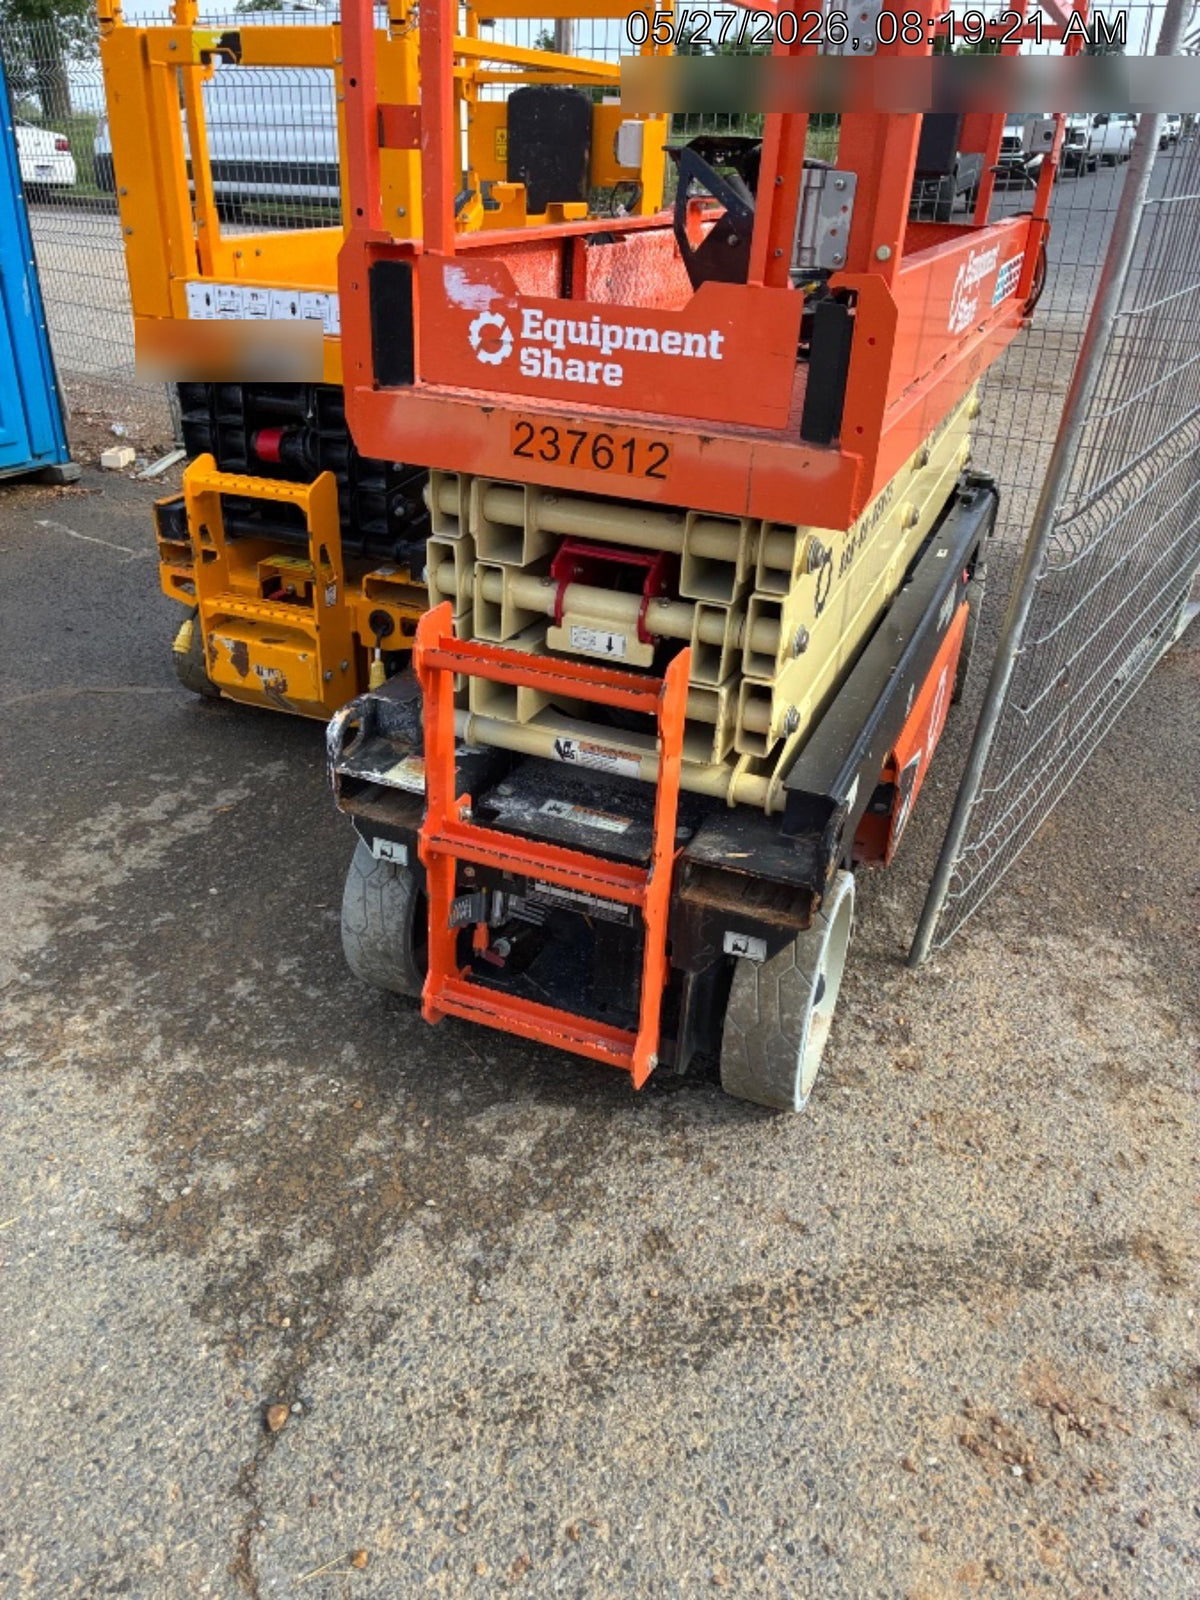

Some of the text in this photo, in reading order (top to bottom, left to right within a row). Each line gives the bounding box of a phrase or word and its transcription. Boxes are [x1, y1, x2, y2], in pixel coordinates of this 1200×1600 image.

[520, 308, 725, 360] Equipment
[519, 347, 624, 387] Share
[513, 421, 671, 480] 237612
